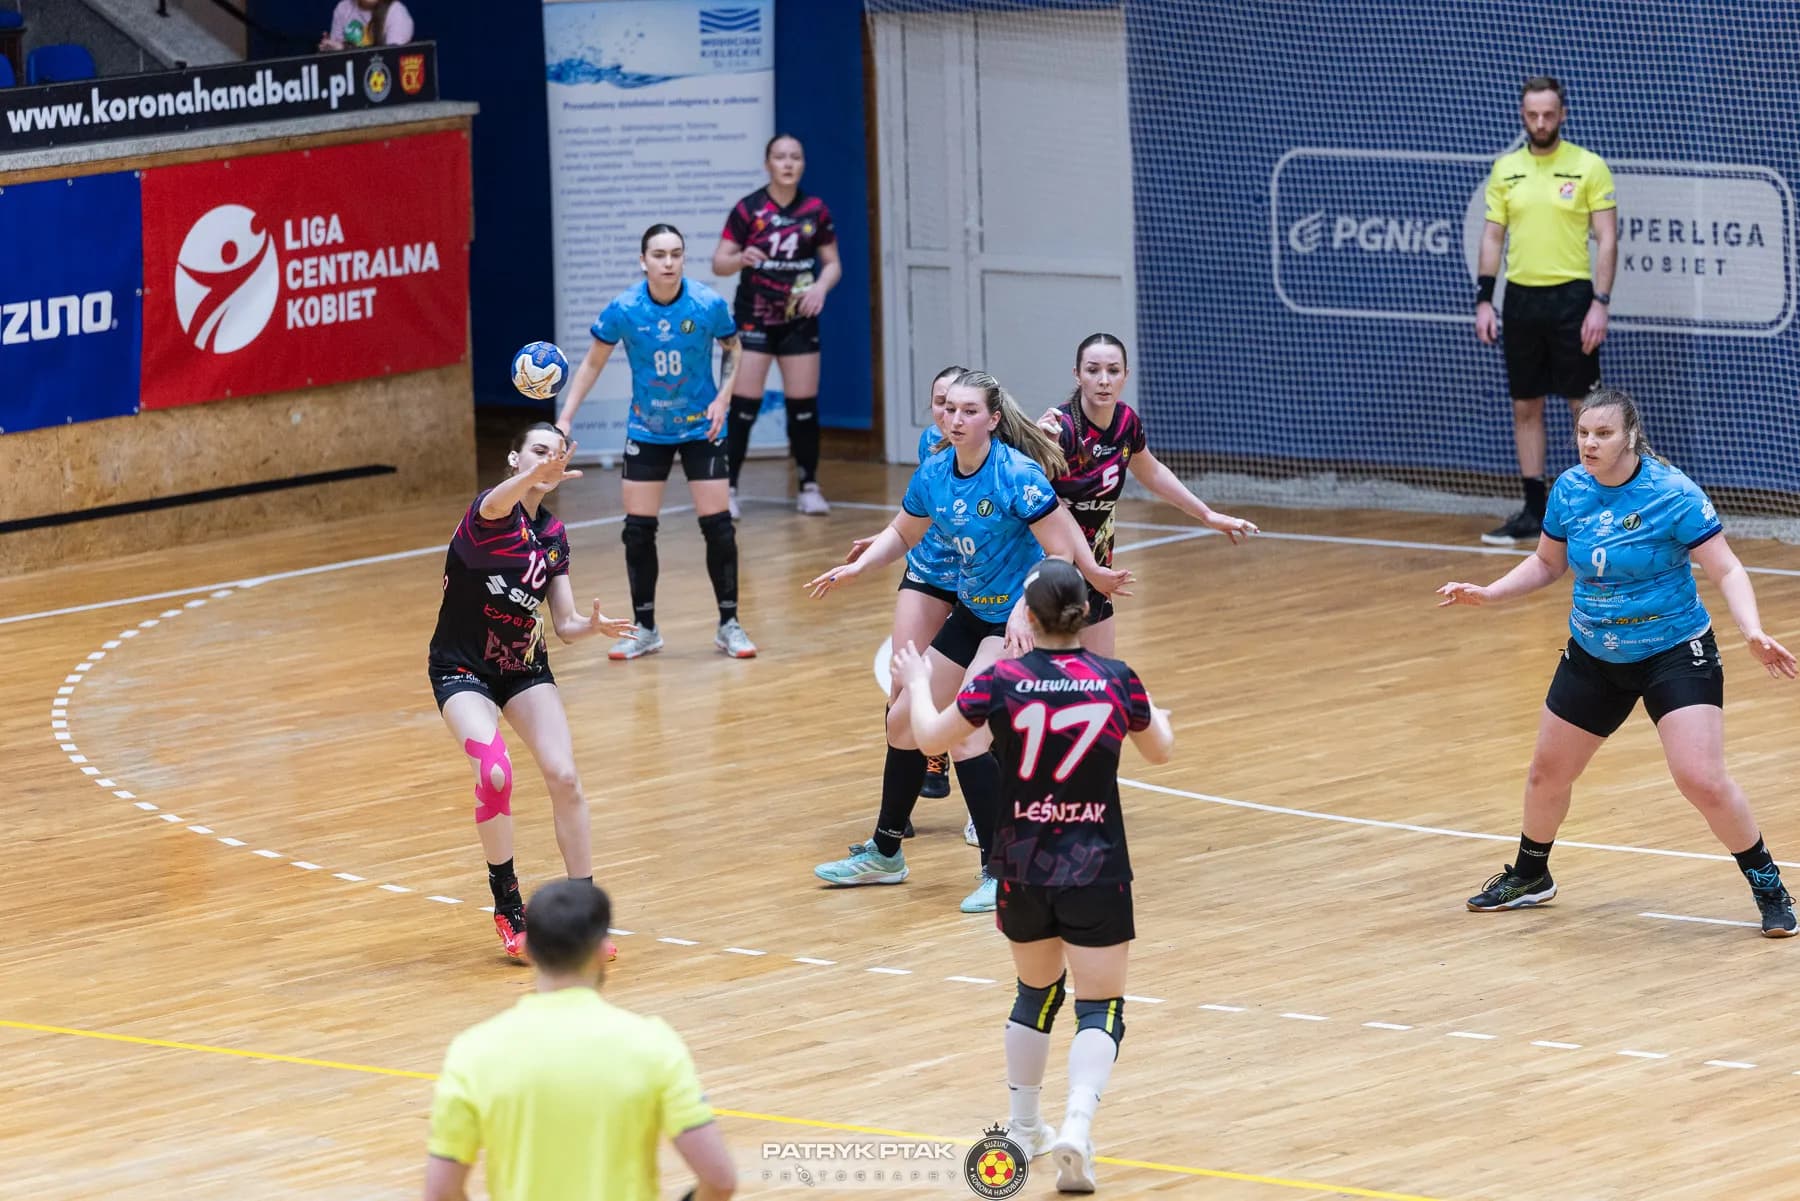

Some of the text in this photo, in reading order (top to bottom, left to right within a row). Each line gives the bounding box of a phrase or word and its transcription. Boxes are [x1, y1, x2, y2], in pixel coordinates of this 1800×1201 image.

[7, 60, 354, 134] www.koronahandball.pl
[284, 213, 344, 251] LIGA
[768, 232, 799, 259] 14
[1333, 216, 1452, 255] PGNiG
[286, 242, 440, 290] CENTRALNA
[1624, 255, 1727, 276] KOBIET
[0, 290, 113, 345] ZUNO
[286, 288, 377, 330] KOBIET
[654, 350, 683, 376] 88
[1096, 464, 1120, 497] 5
[953, 536, 976, 564] 10
[1591, 547, 1607, 577] 9
[1034, 679, 1108, 692] LEWIATAN
[1013, 701, 1114, 782] 17
[1013, 794, 1107, 824] LEŚNIAK
